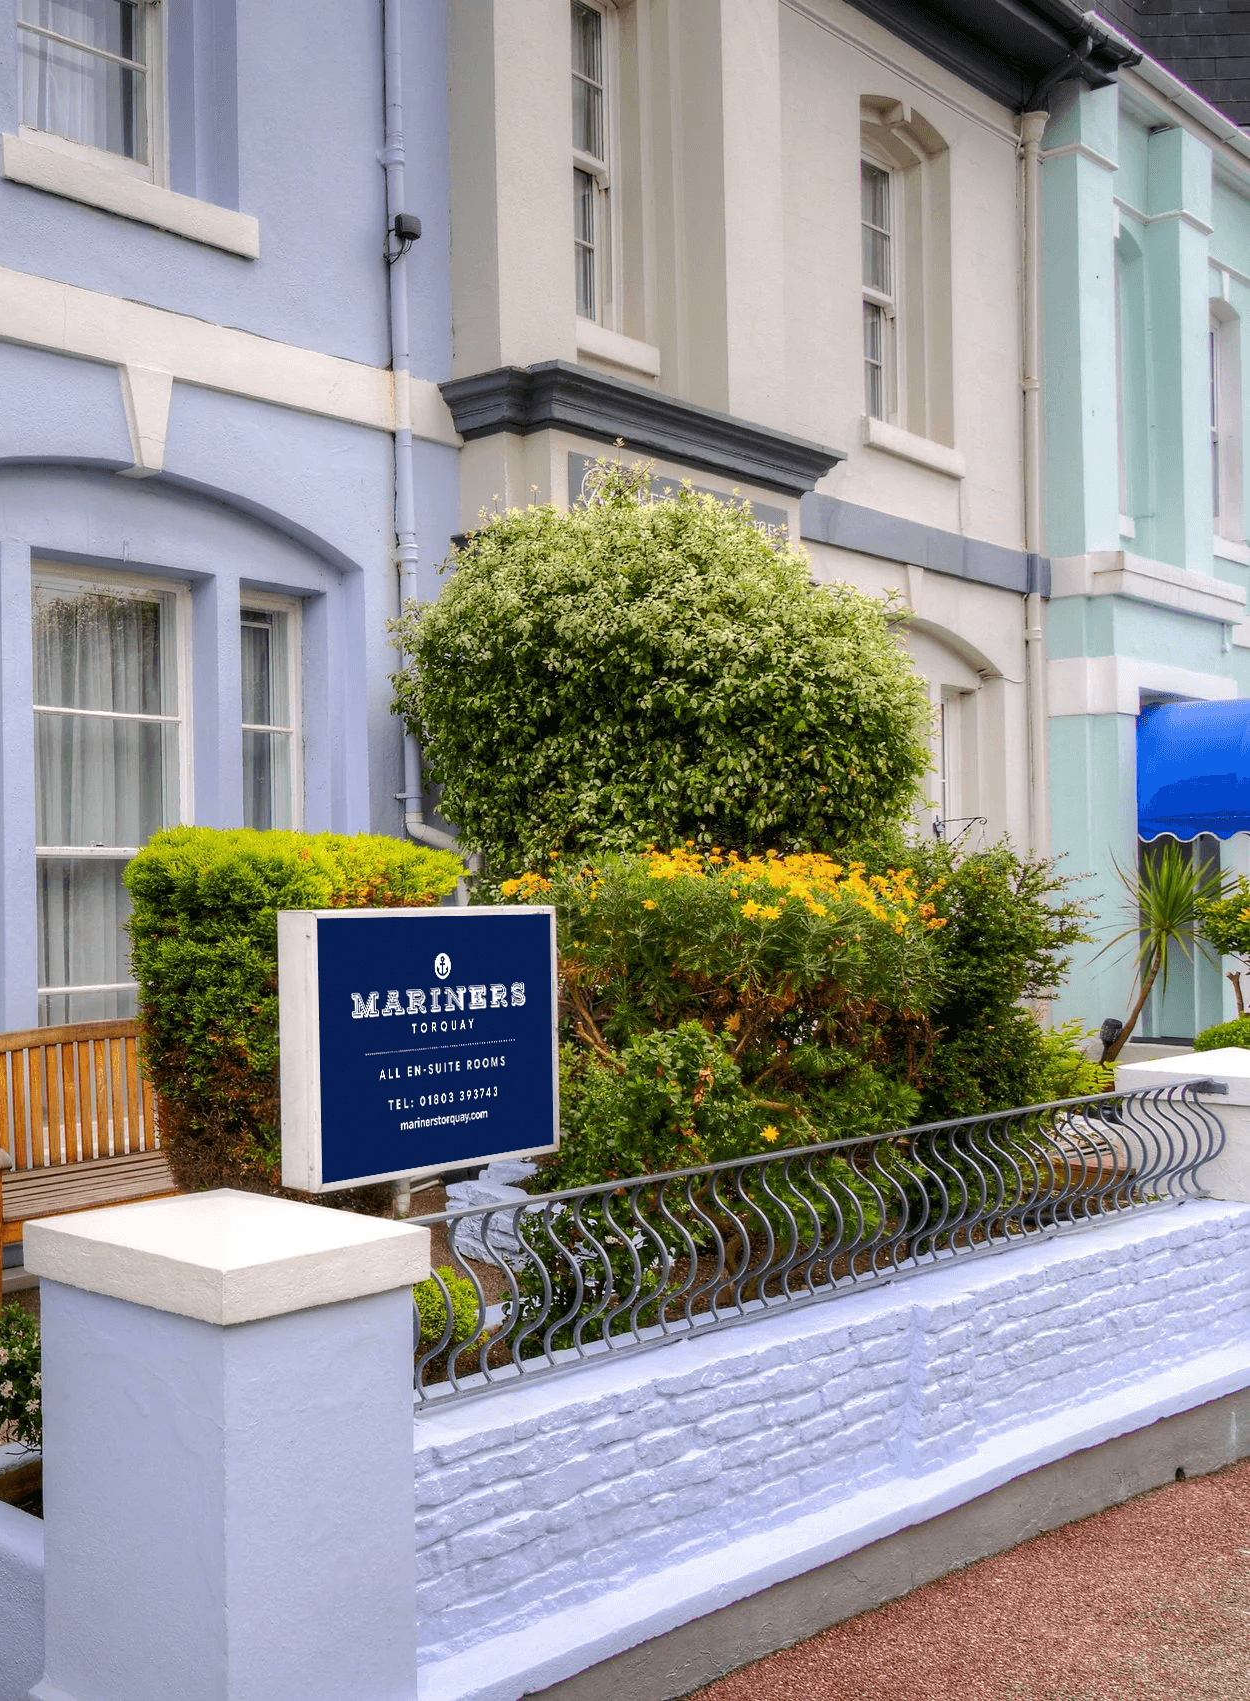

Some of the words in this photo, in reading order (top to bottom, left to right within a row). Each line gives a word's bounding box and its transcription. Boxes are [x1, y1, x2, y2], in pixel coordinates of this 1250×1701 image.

[351, 981, 526, 1019] MARINERS
[411, 1018, 474, 1034] TORQUAY
[379, 1068, 401, 1081] ALL
[407, 1060, 461, 1077] EN-SUITE
[466, 1055, 506, 1070] ROOMS
[388, 1097, 414, 1111] TEL:
[419, 1092, 454, 1107] 01803
[459, 1085, 498, 1102] 393743
[400, 1110, 488, 1131] marinerstorquay.com
